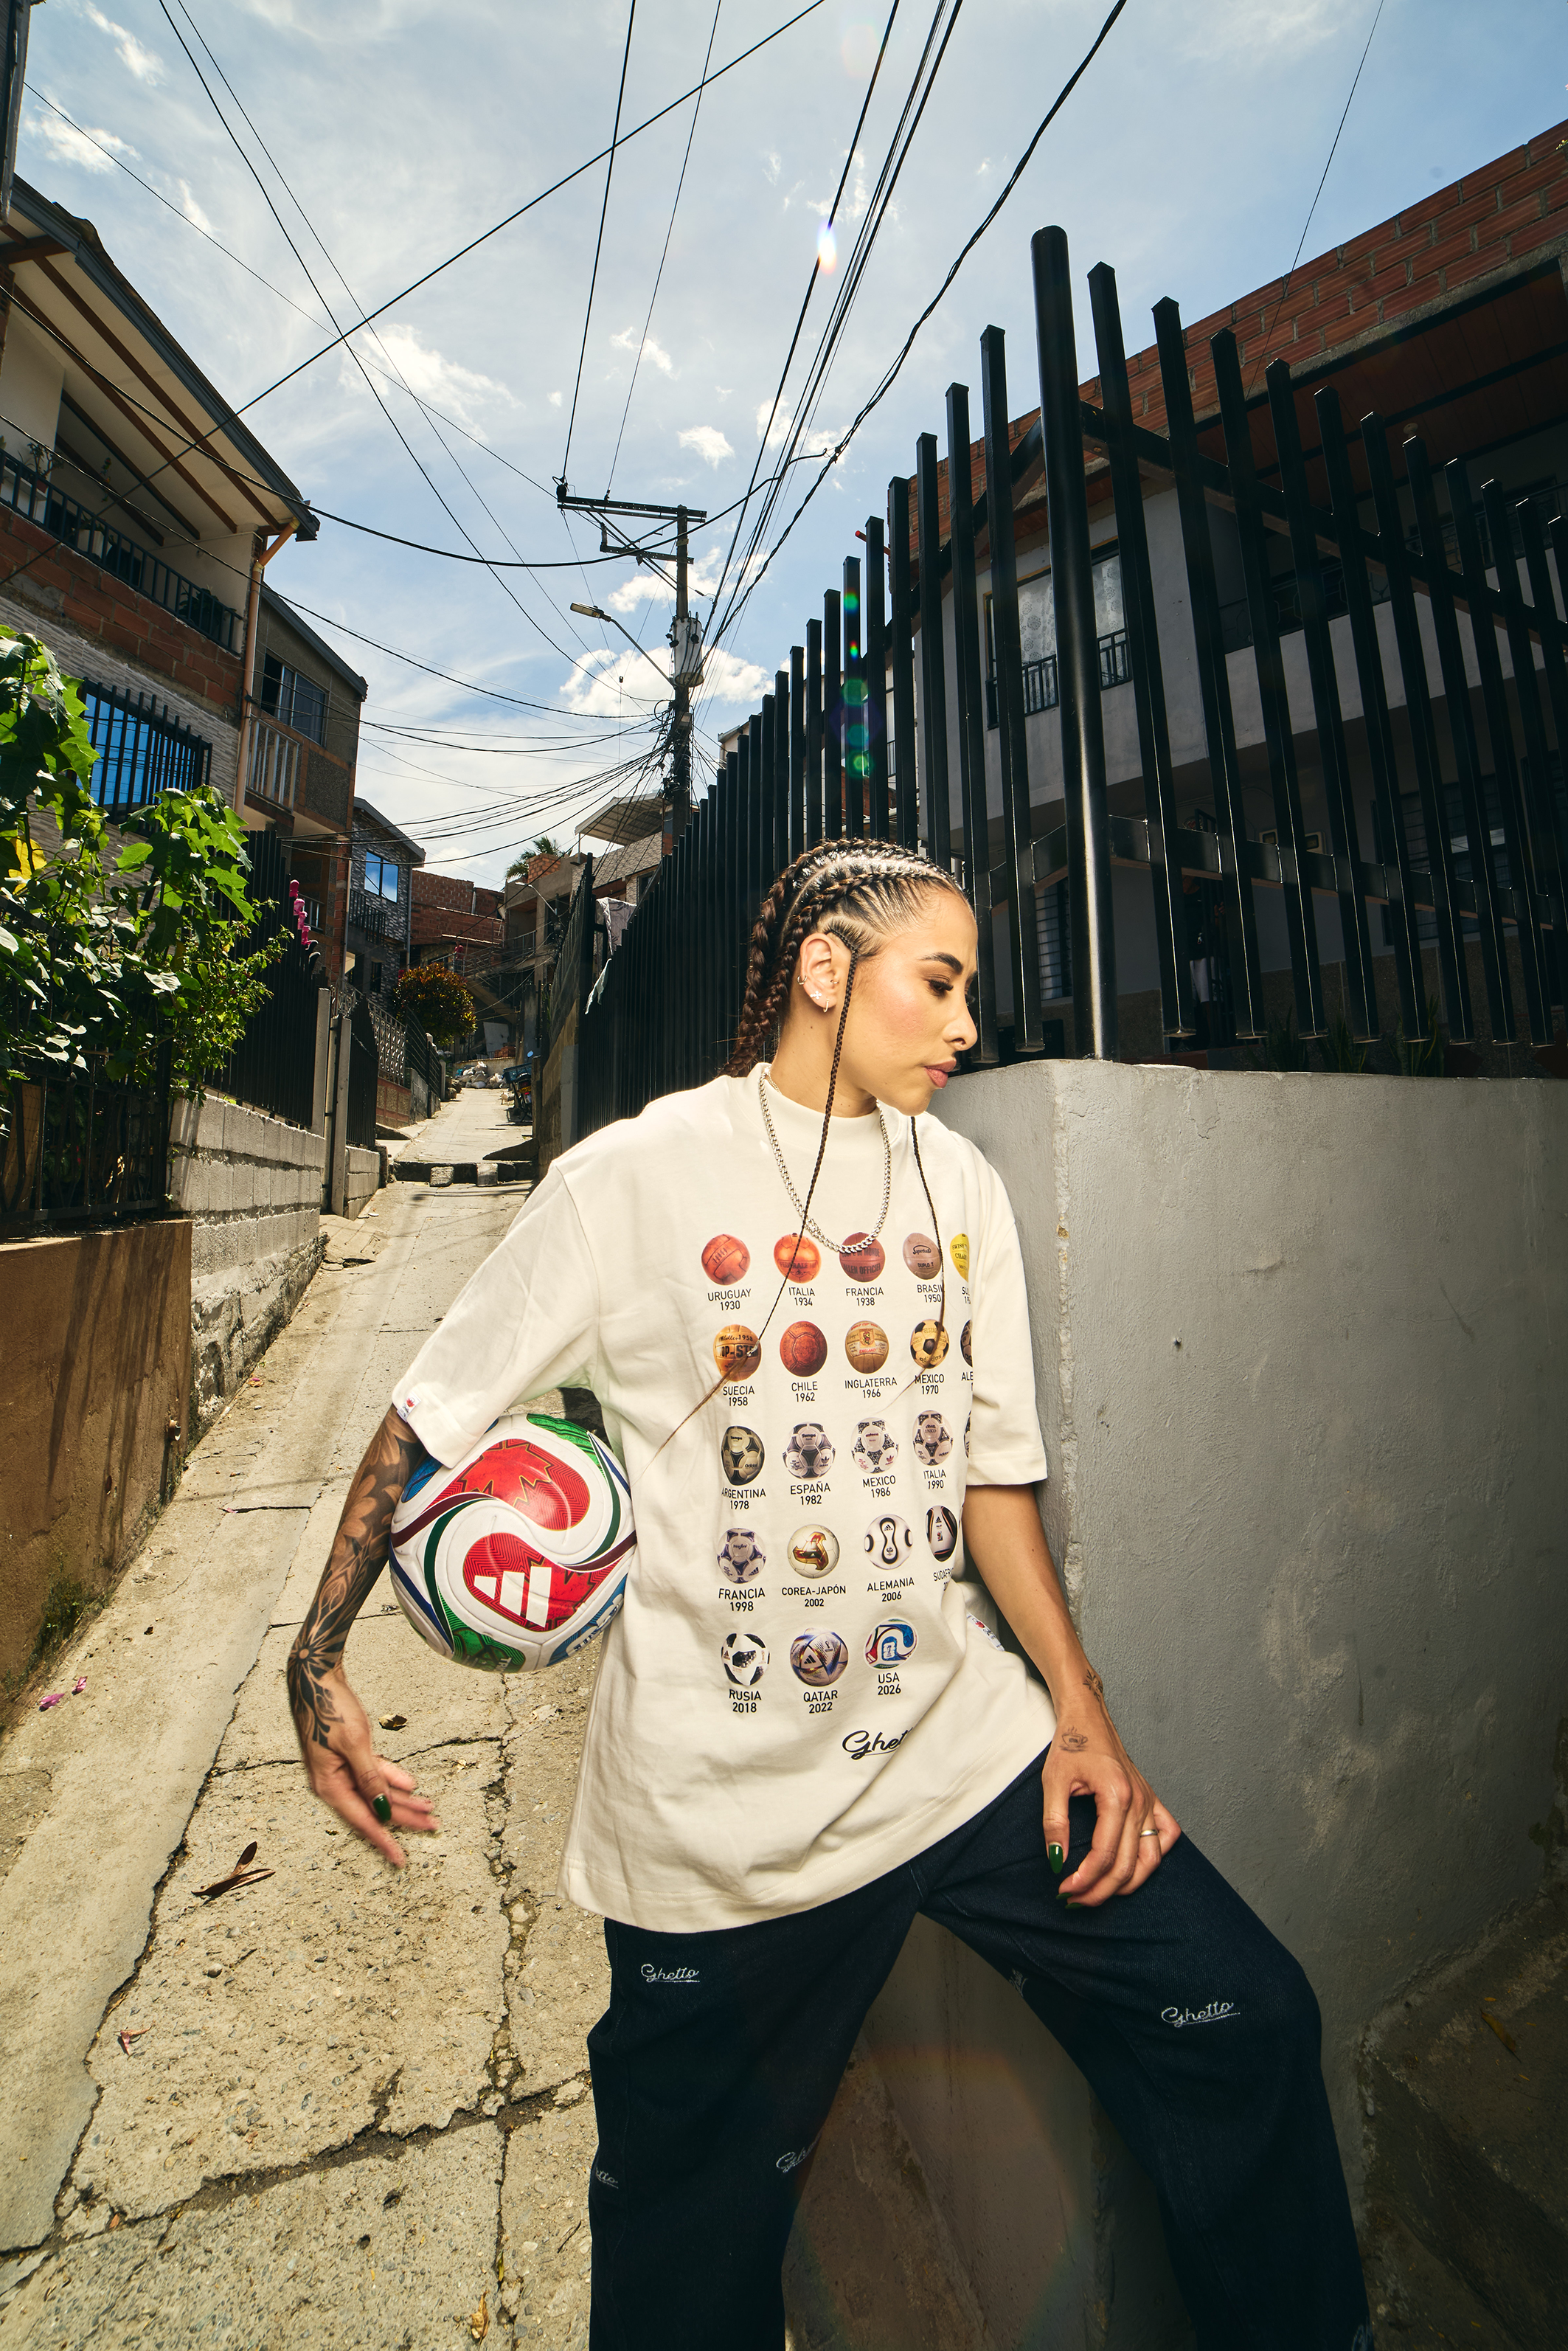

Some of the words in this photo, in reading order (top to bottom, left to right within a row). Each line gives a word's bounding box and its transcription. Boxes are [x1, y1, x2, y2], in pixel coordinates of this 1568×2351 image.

[707, 1288, 752, 1301] URUGUAY
[788, 1287, 816, 1297] ITALIA
[845, 1287, 884, 1297] FRANCIA
[794, 1297, 813, 1306] 1934
[856, 1297, 875, 1306] 1938
[924, 1294, 941, 1303] 1950
[720, 1300, 740, 1311] 1930
[844, 1377, 898, 1389] INGLATERRA
[915, 1374, 945, 1384] MEXICO
[723, 1385, 755, 1396] SUECIA
[791, 1381, 818, 1391] CHILE
[921, 1385, 939, 1395] 1970
[795, 1392, 816, 1402] 1962
[862, 1389, 881, 1399] 1966
[729, 1396, 748, 1407] 1958
[923, 1469, 947, 1480] ITALIA
[862, 1475, 896, 1488] MEXICO
[928, 1479, 945, 1489] 1990
[721, 1487, 766, 1499] ARGENTINA
[790, 1481, 831, 1495] ESPAÑA
[871, 1487, 891, 1498] 1986
[730, 1500, 749, 1510] 1978
[800, 1495, 822, 1506] 1982
[867, 1576, 915, 1592] ALEMANIA
[718, 1587, 766, 1600] FRANCIA
[781, 1584, 847, 1596] COREA-JAPÓN
[881, 1591, 902, 1602] 2006
[729, 1601, 754, 1612] 1998
[804, 1598, 825, 1607] 2002
[878, 1672, 900, 1683] USA
[877, 1683, 901, 1695] 2026
[729, 1689, 762, 1701] RUSIA
[803, 1690, 839, 1703] QATAR
[732, 1702, 757, 1713] 2018
[808, 1701, 833, 1714] 2022
[842, 1727, 914, 1760] Ghet
[640, 1963, 700, 1983] Ghetto
[1161, 2001, 1239, 2028] Ghetto
